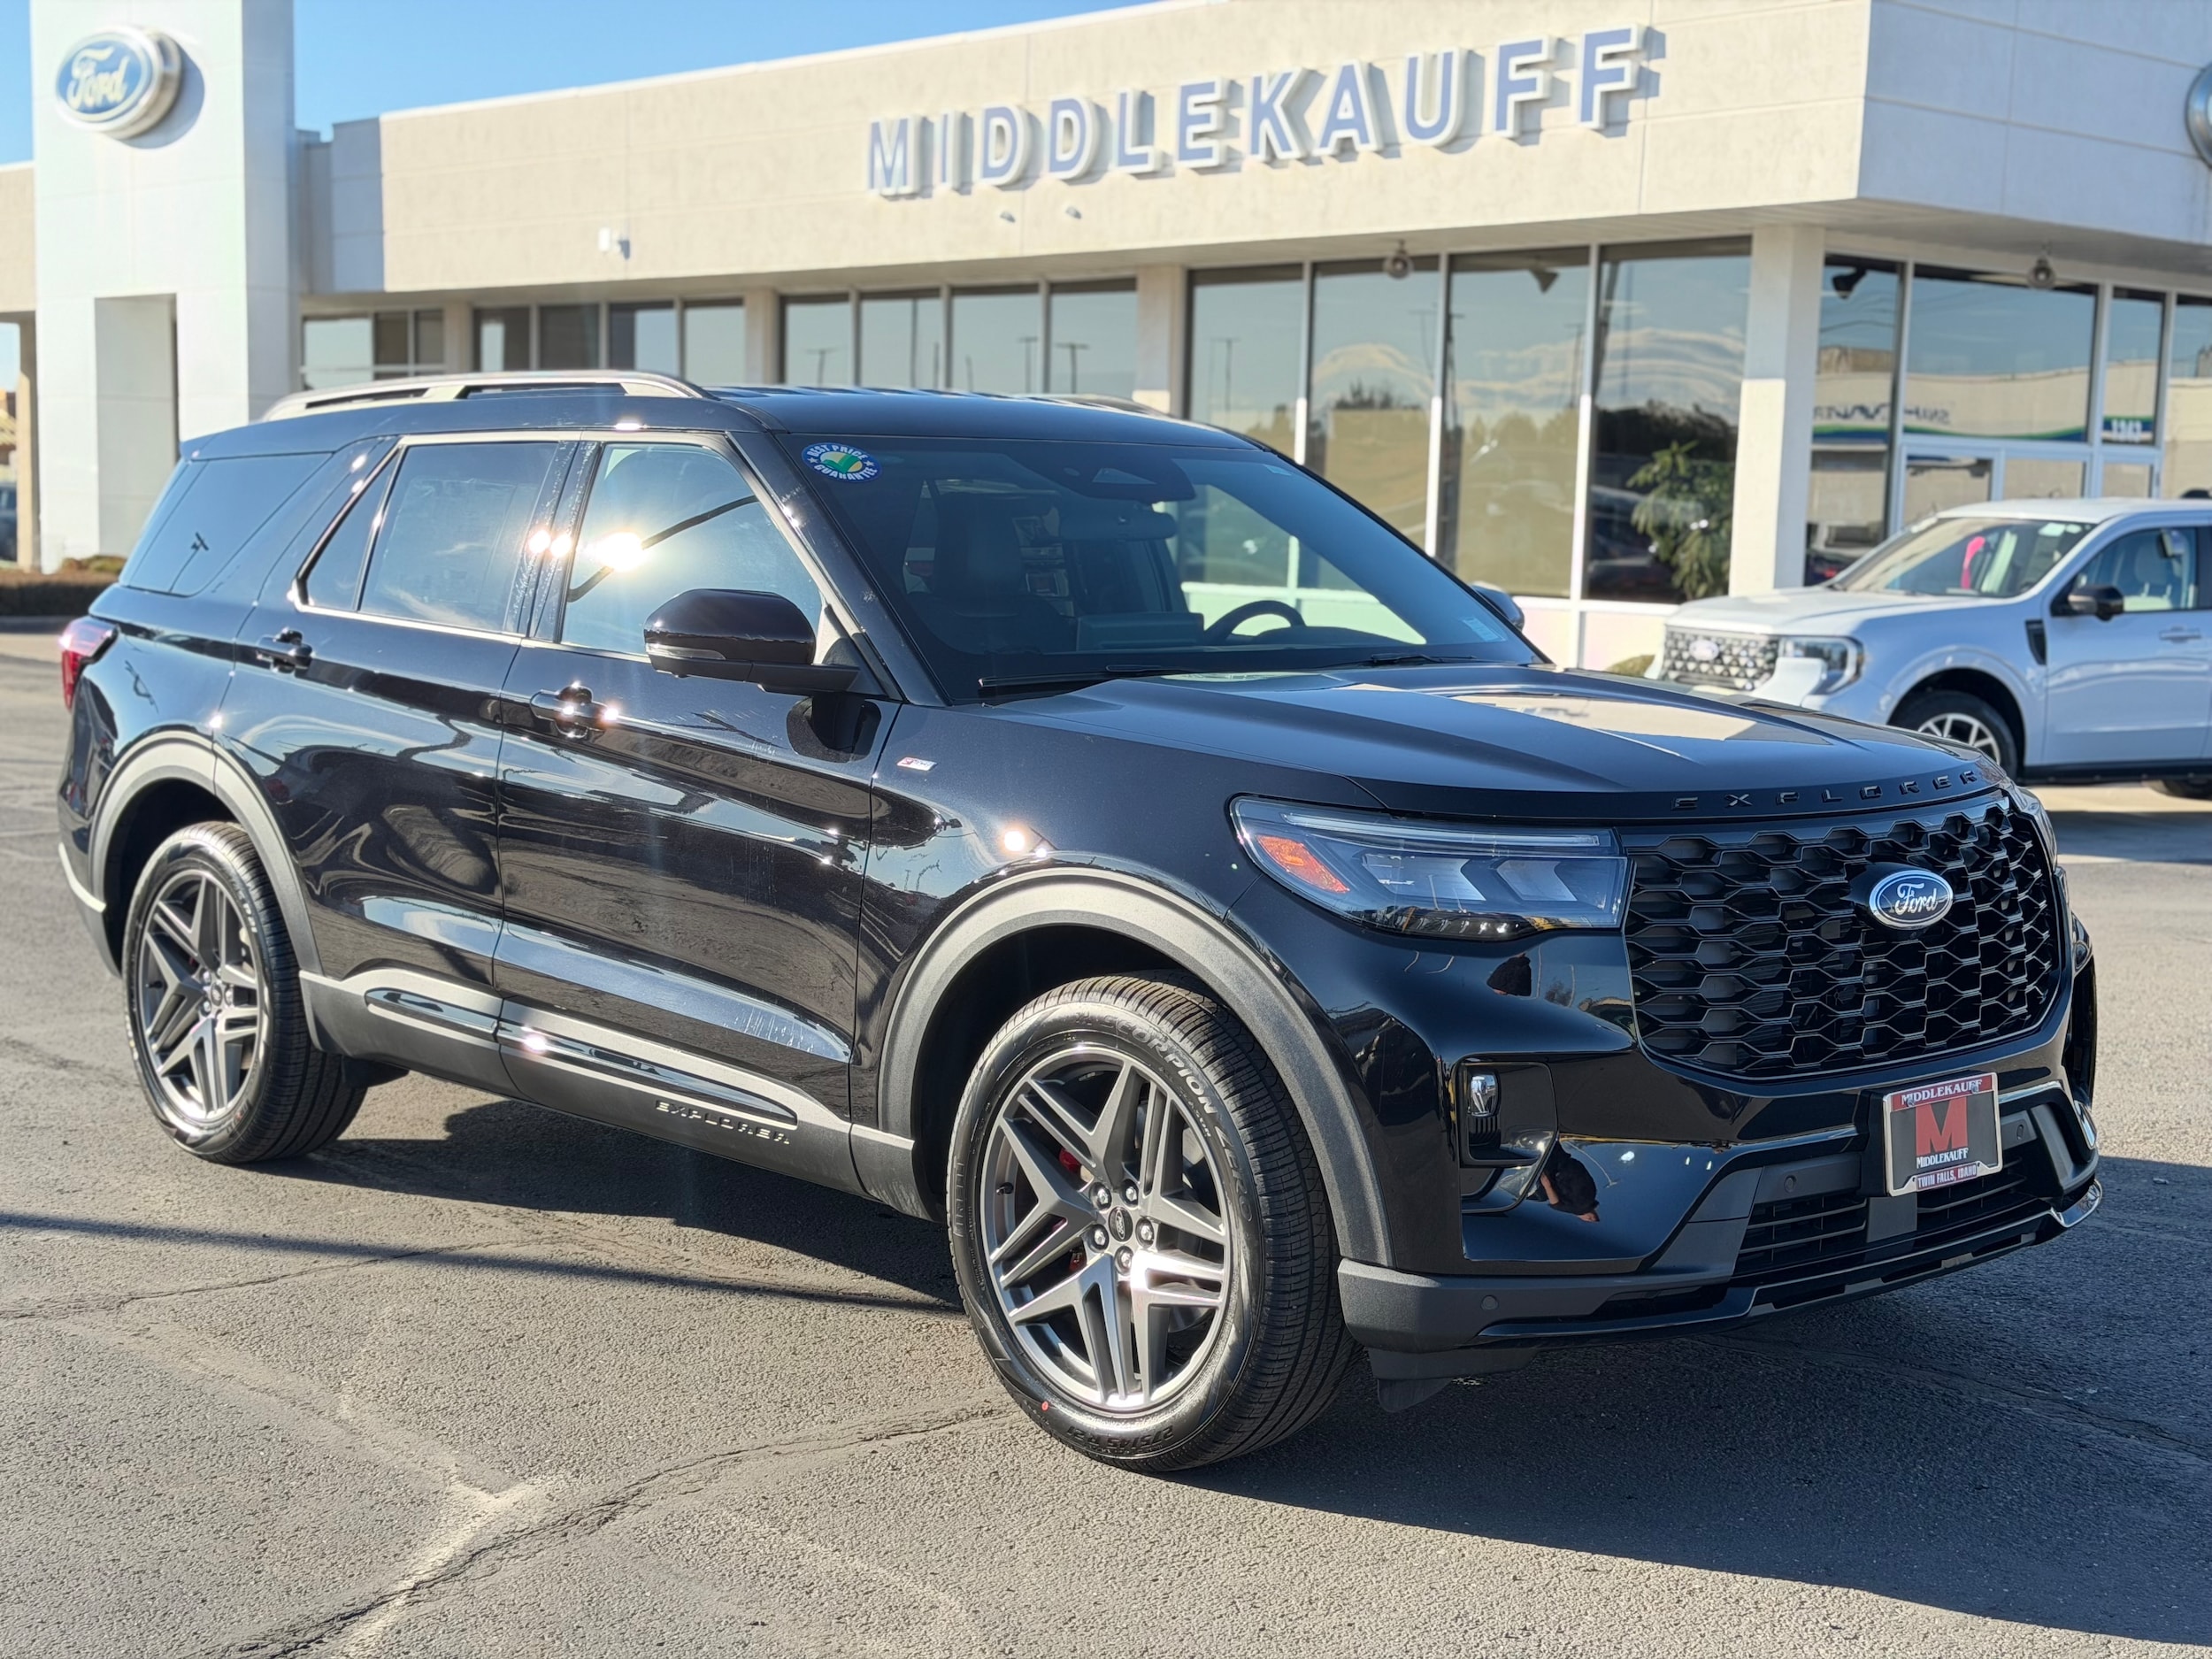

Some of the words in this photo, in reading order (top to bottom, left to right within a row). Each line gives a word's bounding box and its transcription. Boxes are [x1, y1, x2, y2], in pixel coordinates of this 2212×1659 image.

[66, 45, 130, 110] Ford
[868, 22, 1649, 196] MIDDLEKAUFF
[806, 444, 831, 457] BEST
[832, 445, 869, 460] PRICE
[813, 464, 879, 480] GUARANTEE
[1671, 769, 1978, 810] EXPLORER
[1894, 882, 1938, 916] Ford
[1100, 1014, 1218, 1115] SCORPION
[1901, 1079, 1983, 1106] MIDDLEKAUFF
[656, 1100, 790, 1145] EXPLORER
[1916, 1097, 1969, 1156] M
[1215, 1125, 1254, 1223] ZERO
[1916, 1147, 1970, 1170] MIDDLEKAUFF
[1917, 1171, 1936, 1188] TWIN
[1936, 1168, 1956, 1186] FALLS,
[1957, 1164, 1978, 1179] IDAHO
